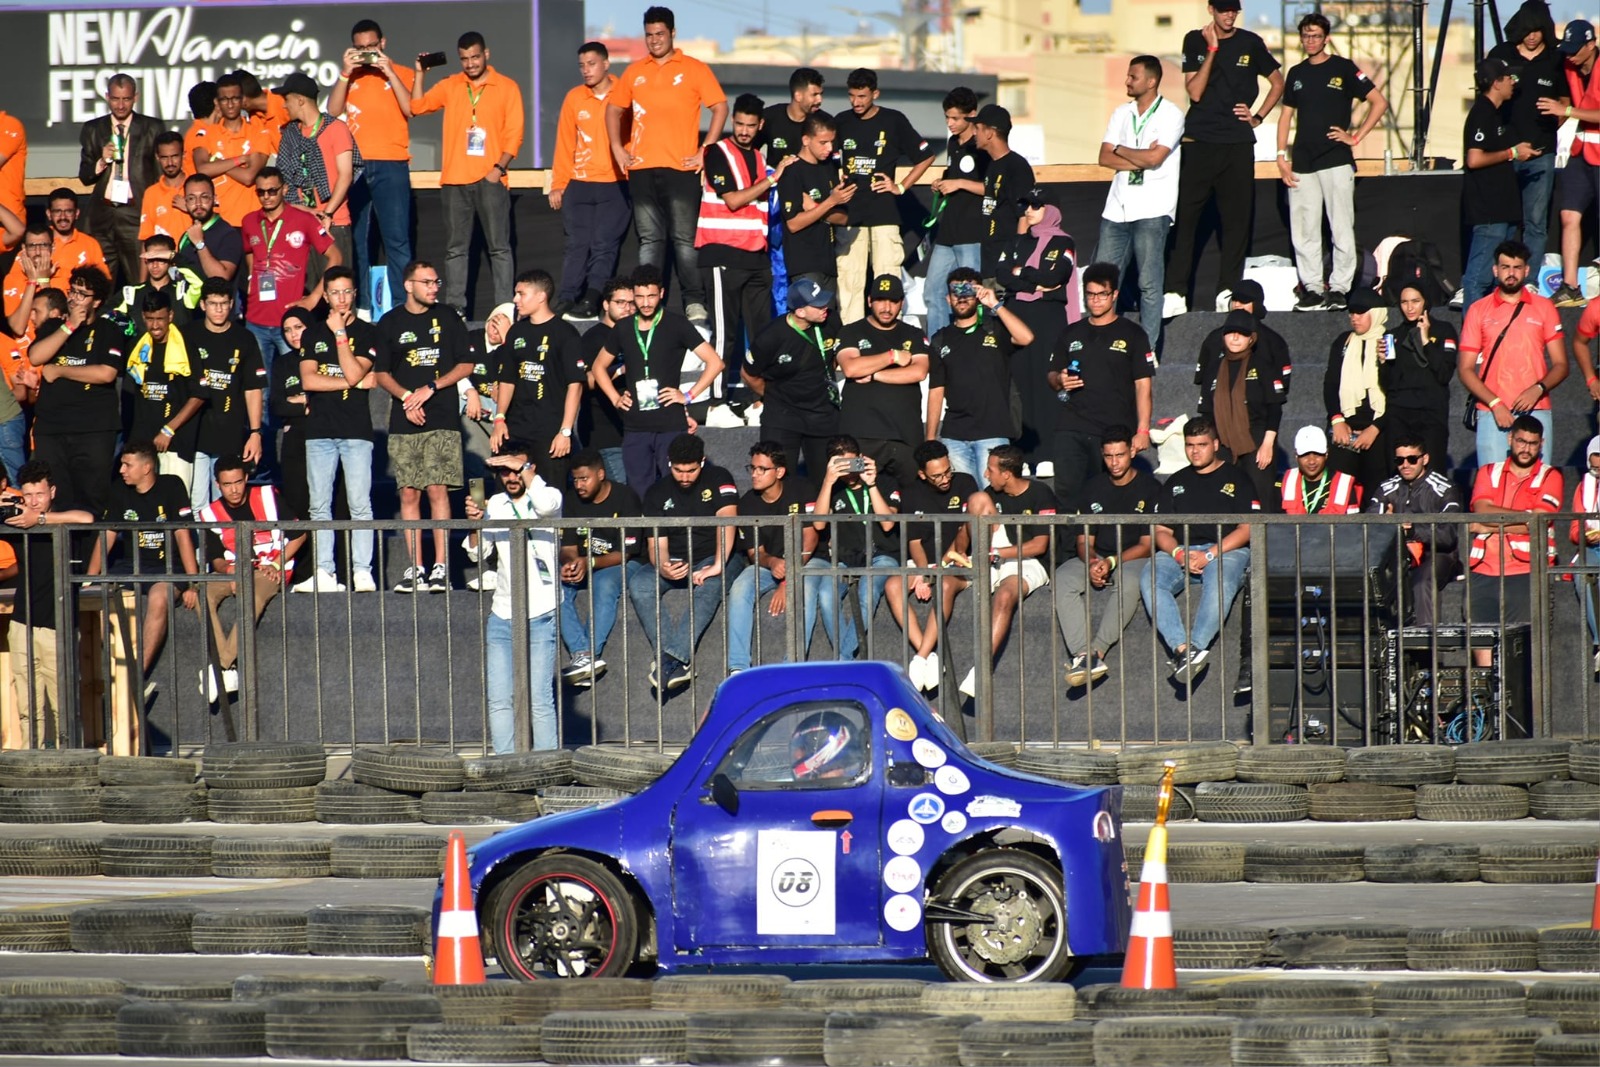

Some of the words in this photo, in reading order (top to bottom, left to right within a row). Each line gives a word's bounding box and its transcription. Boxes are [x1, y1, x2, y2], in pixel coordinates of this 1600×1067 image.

[48, 11, 140, 65] NEW
[128, 5, 320, 65] Alamein
[778, 871, 814, 893] 08
